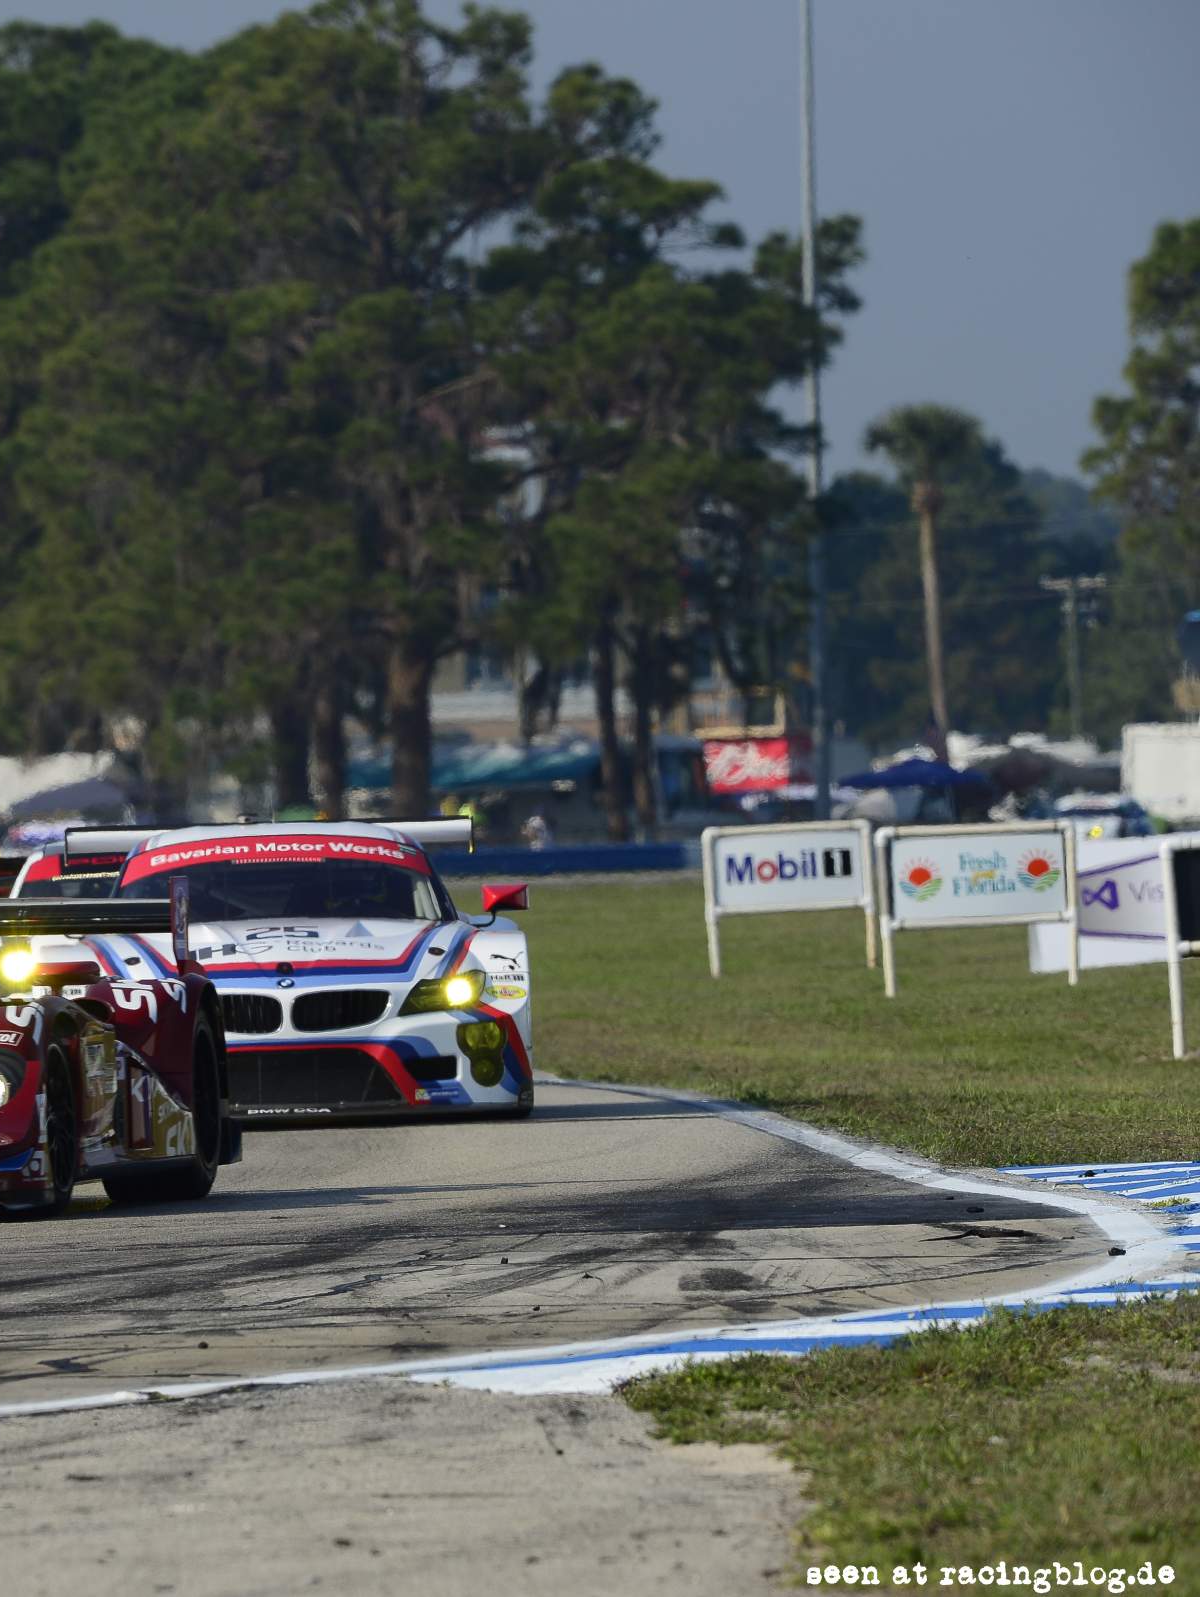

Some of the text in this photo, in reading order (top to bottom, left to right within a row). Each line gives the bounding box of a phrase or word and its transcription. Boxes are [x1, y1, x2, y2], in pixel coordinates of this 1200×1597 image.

[150, 842, 405, 867] Bavarian Motor Works
[726, 851, 817, 884] Mobil
[246, 926, 320, 940] 25
